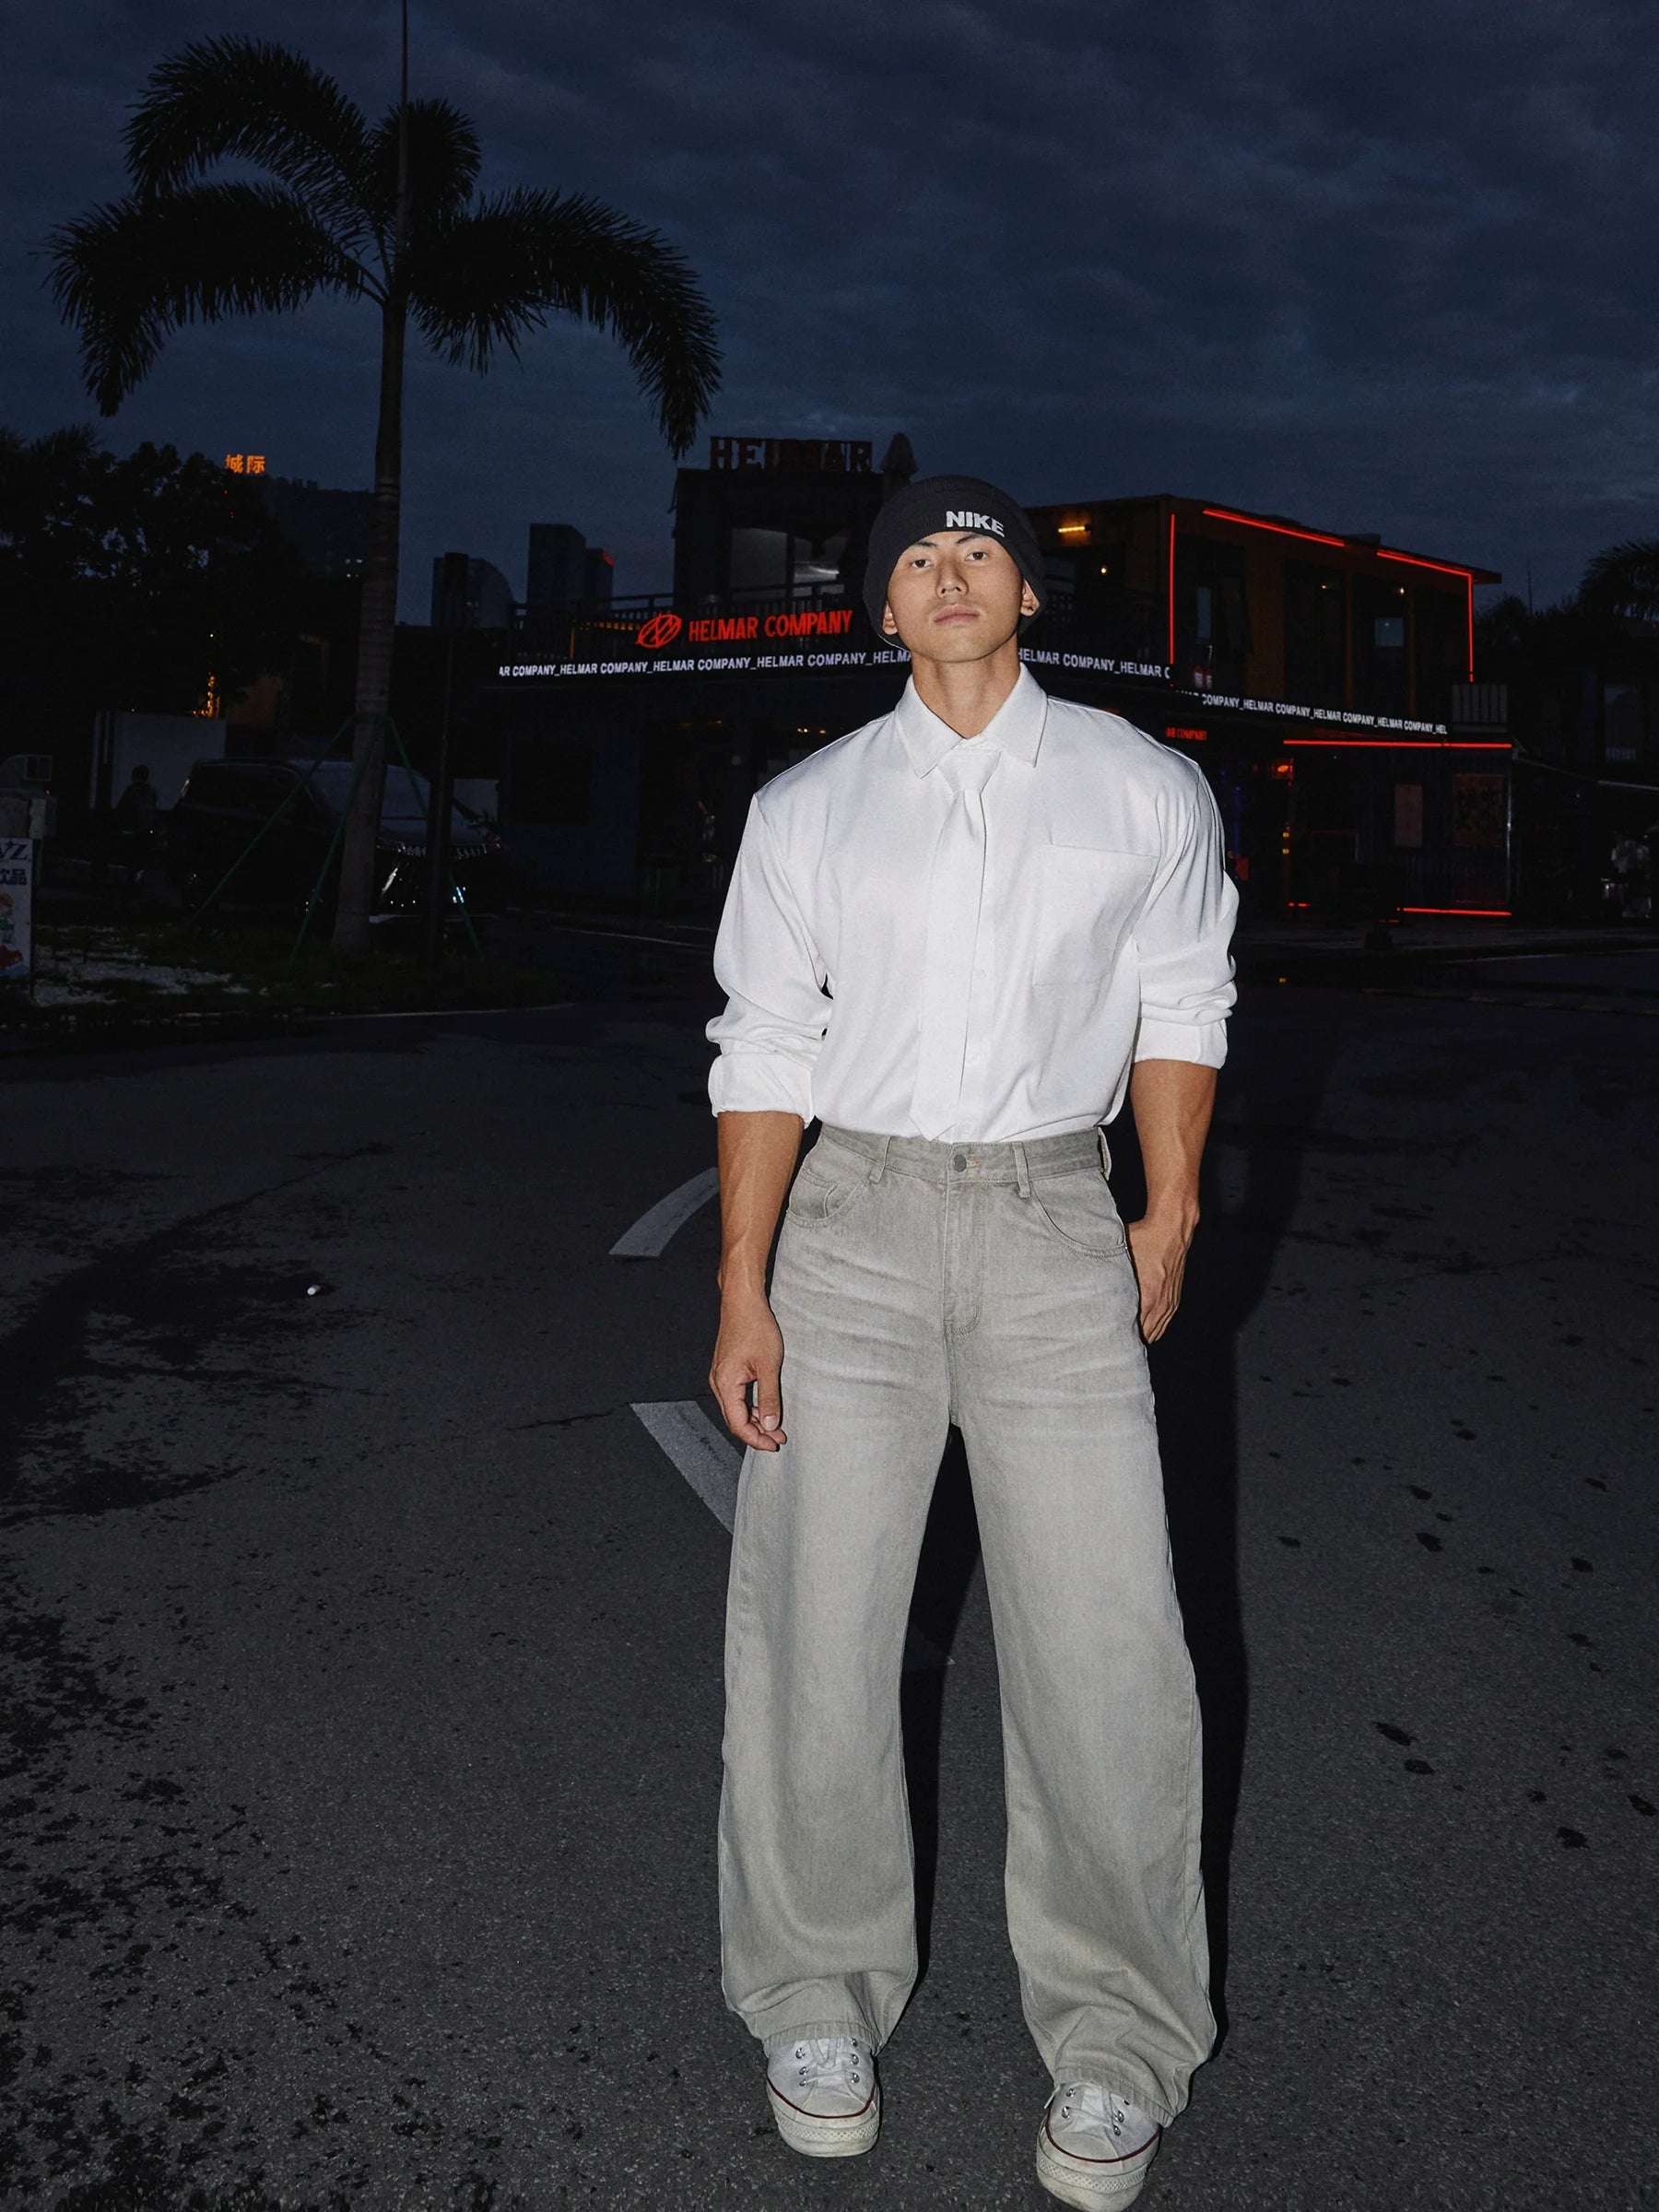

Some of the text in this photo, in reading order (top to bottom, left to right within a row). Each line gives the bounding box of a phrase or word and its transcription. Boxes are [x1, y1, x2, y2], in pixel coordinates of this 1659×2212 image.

[225, 453, 265, 475] 城际
[946, 511, 1006, 537] NIKE
[688, 609, 853, 642] HELMAR COMPANY
